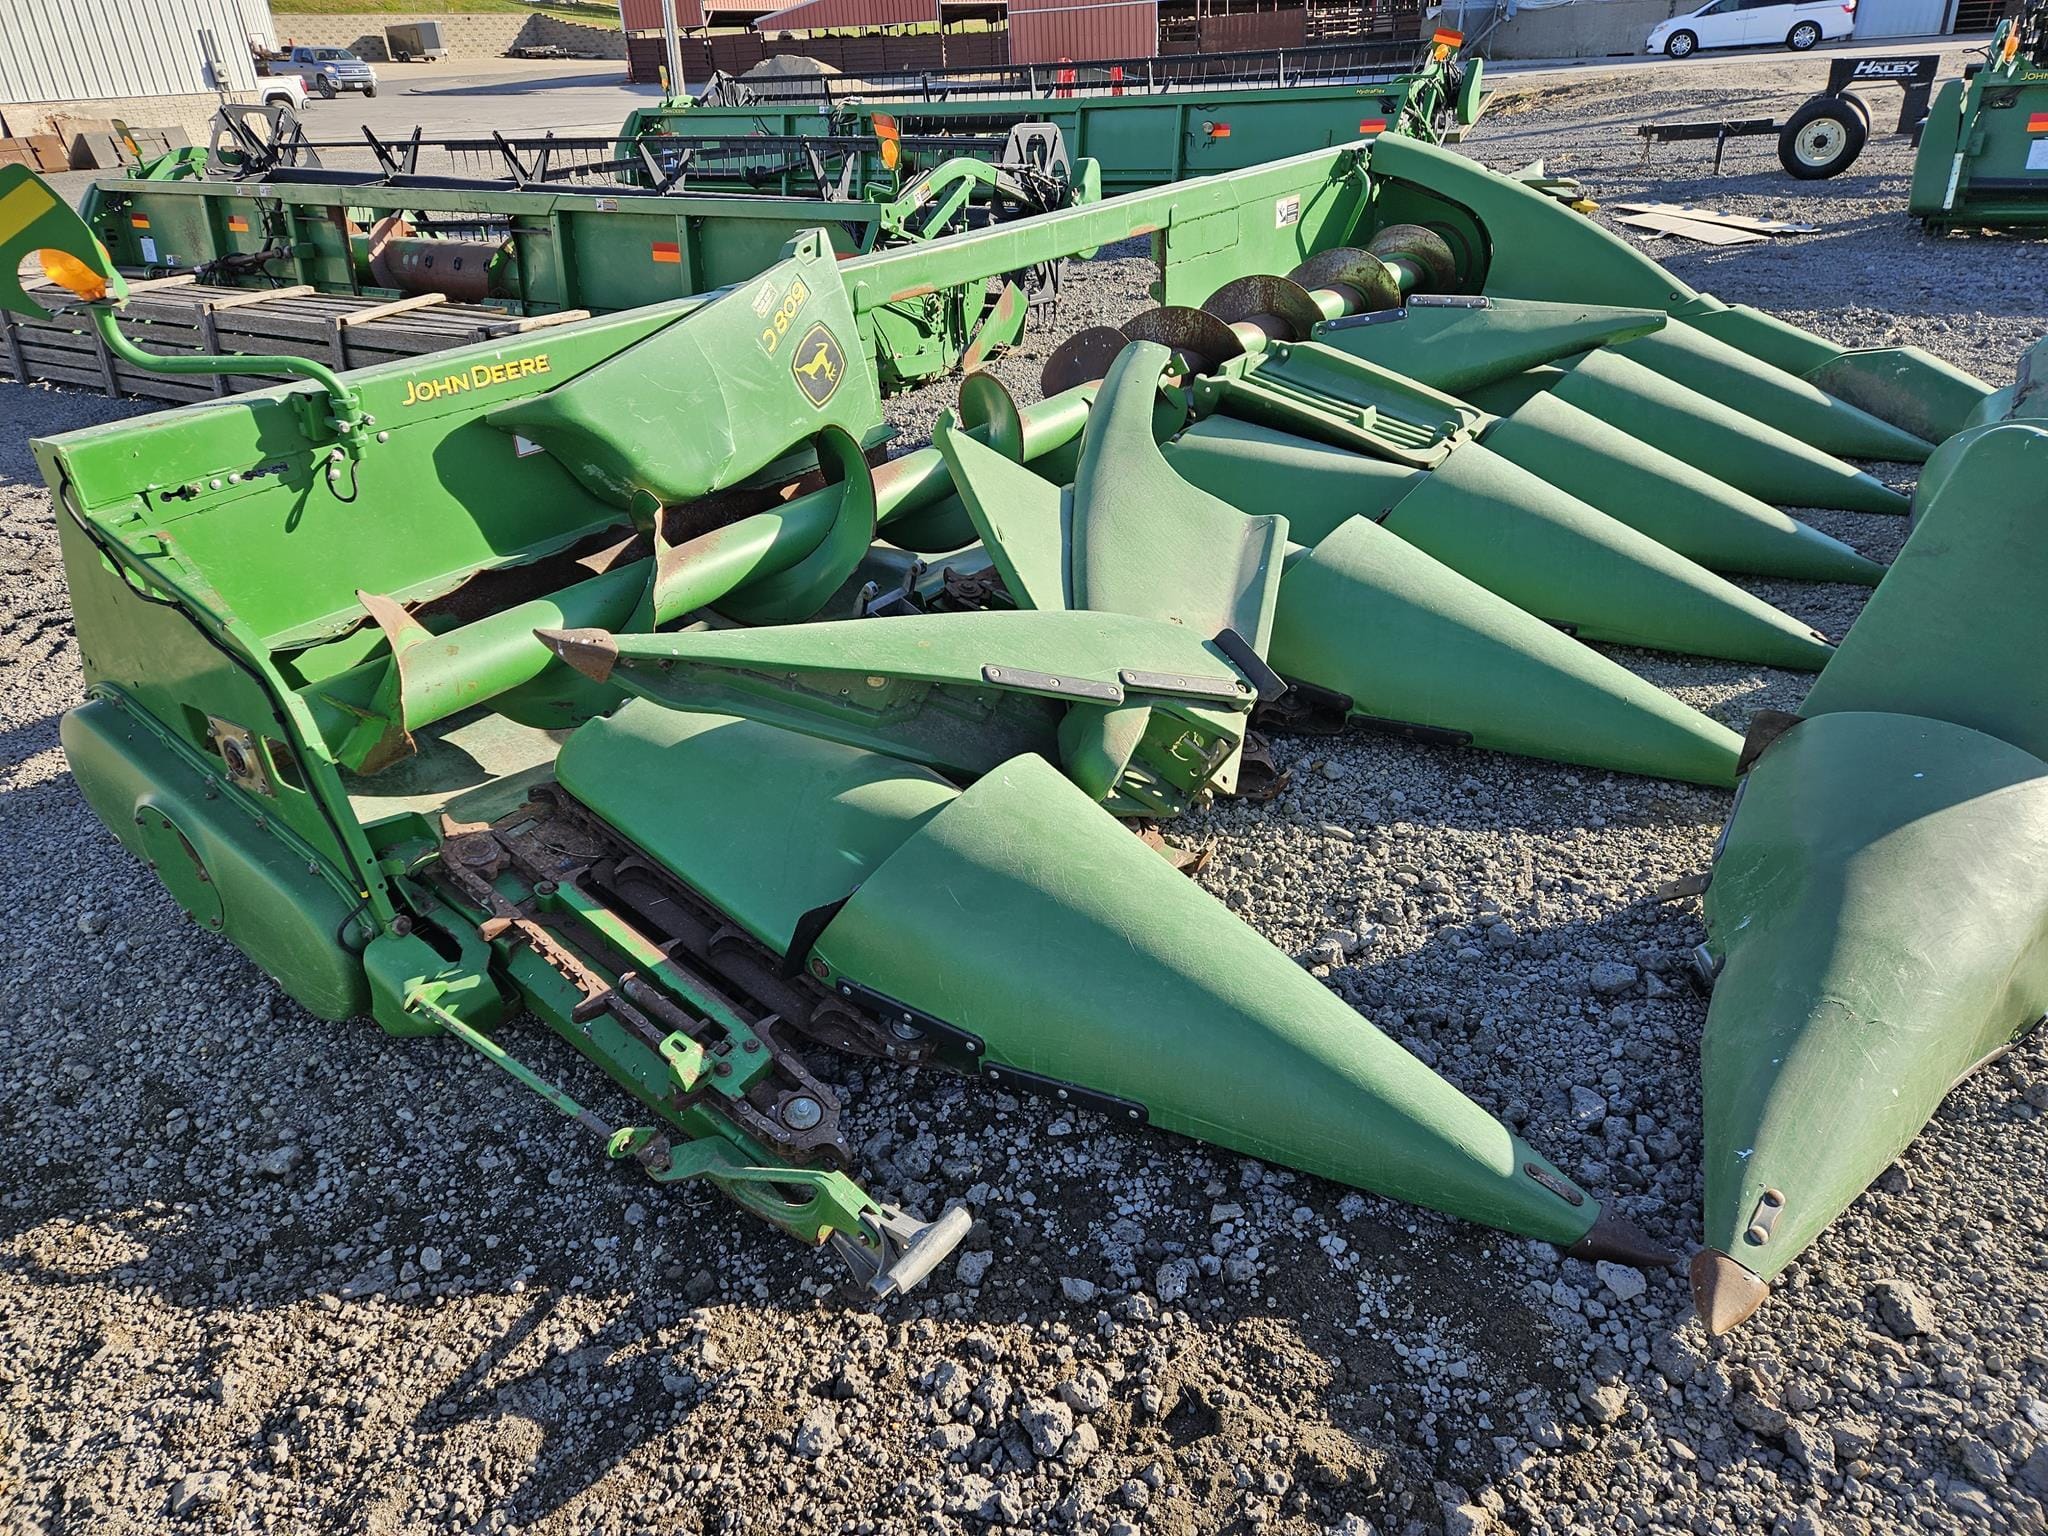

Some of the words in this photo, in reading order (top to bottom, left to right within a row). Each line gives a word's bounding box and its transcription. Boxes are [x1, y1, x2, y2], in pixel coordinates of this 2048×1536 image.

[1854, 61, 1919, 74] HALEY
[402, 373, 471, 406] JOHN
[471, 353, 551, 389] DEERE
